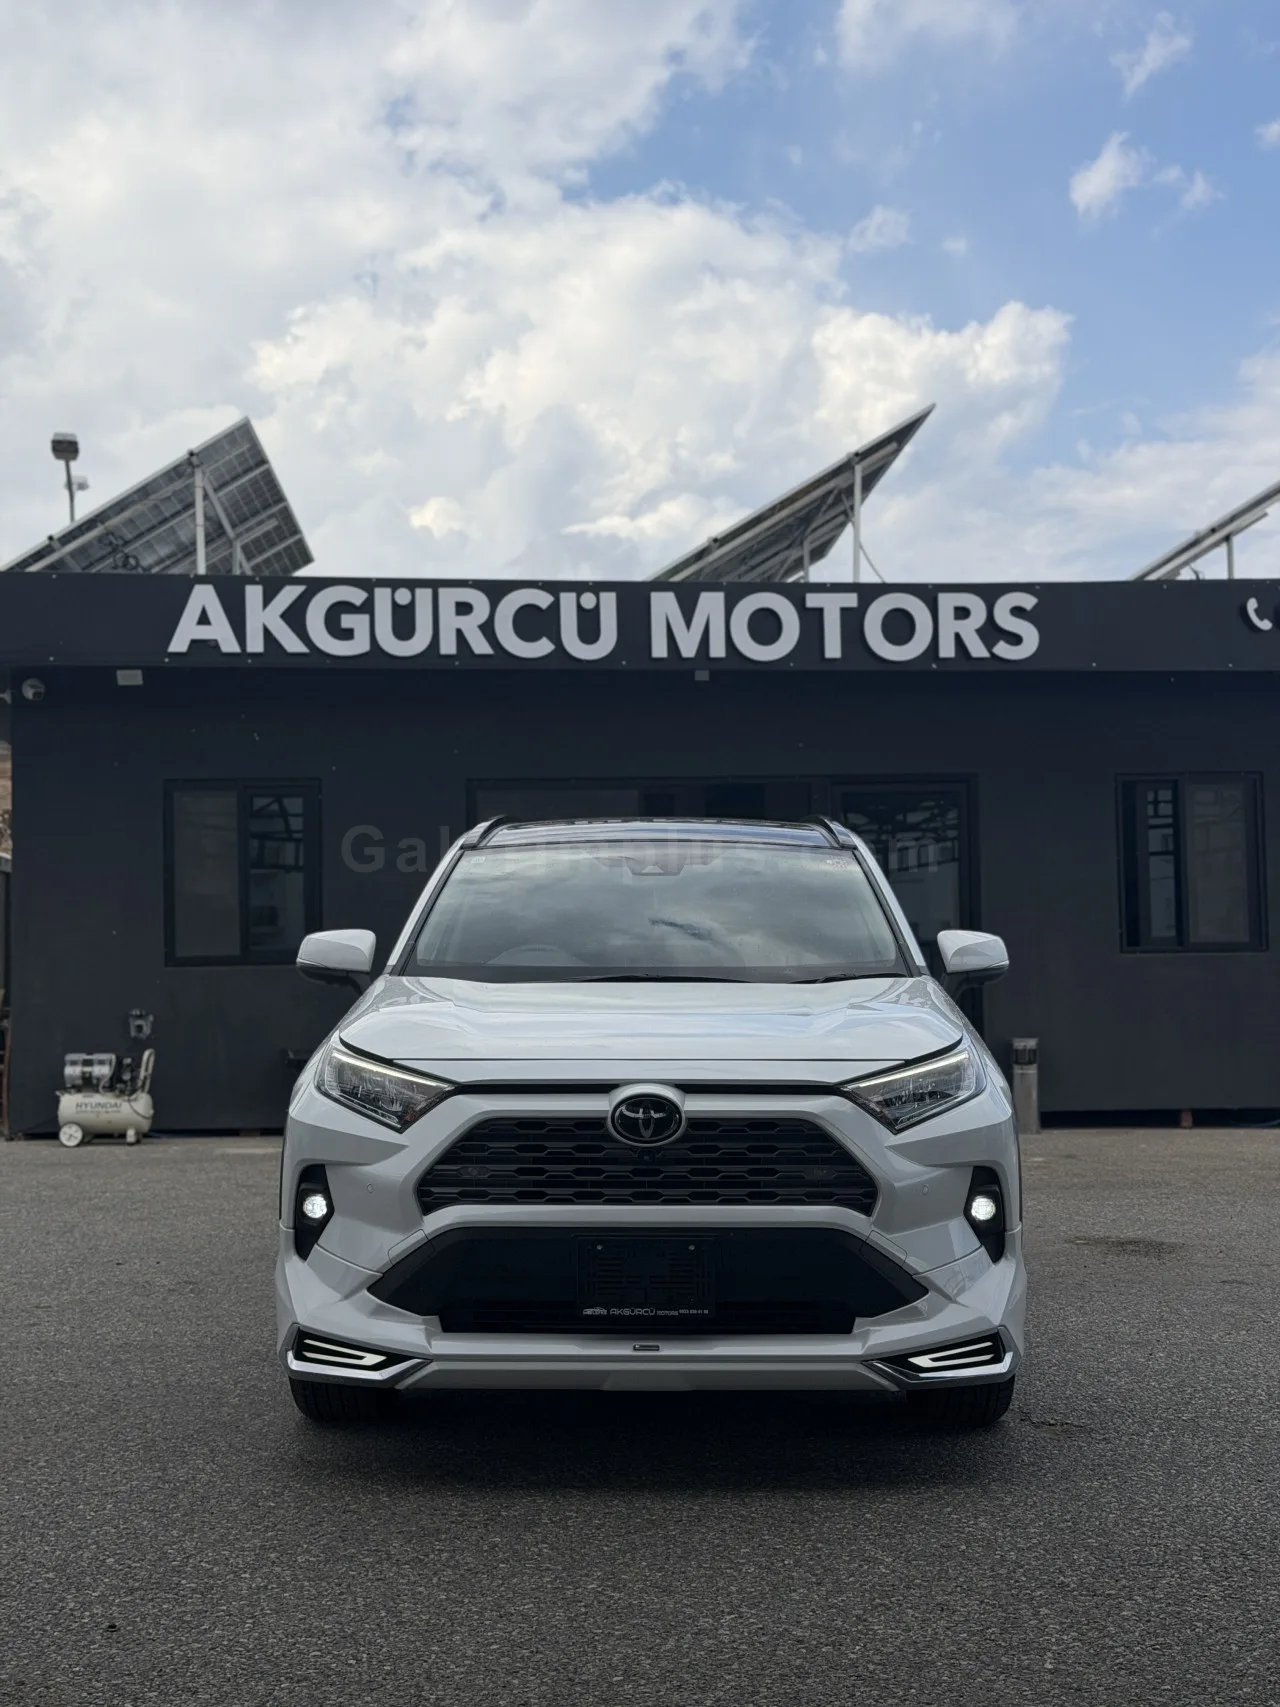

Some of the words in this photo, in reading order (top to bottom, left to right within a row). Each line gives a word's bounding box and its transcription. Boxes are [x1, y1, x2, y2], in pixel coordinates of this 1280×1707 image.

[168, 583, 618, 662] AKGÜRCÜ
[650, 590, 1040, 663] MOTORS
[76, 1101, 122, 1110] HYUNDAI
